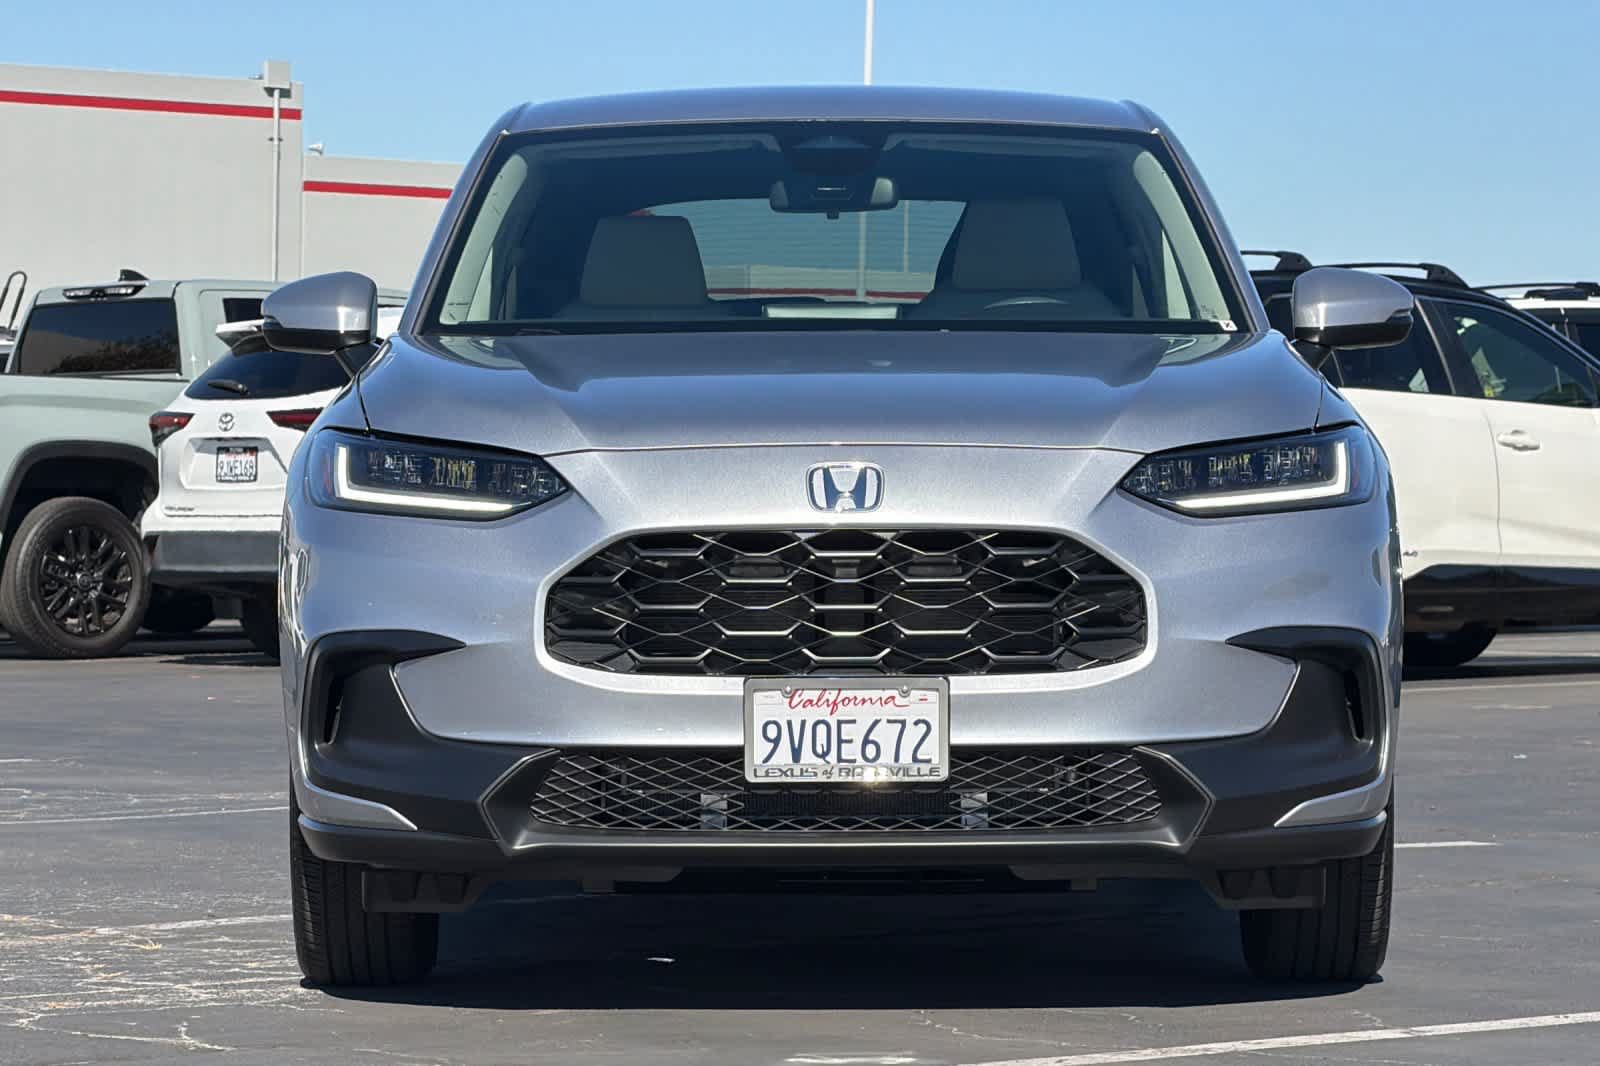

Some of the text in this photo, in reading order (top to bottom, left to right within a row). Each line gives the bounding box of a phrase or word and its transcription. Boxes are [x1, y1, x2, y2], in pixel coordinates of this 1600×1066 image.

[788, 688, 910, 716] California
[761, 718, 932, 764] 9VQE672
[753, 766, 941, 779] LEXUS of ROVILLE
